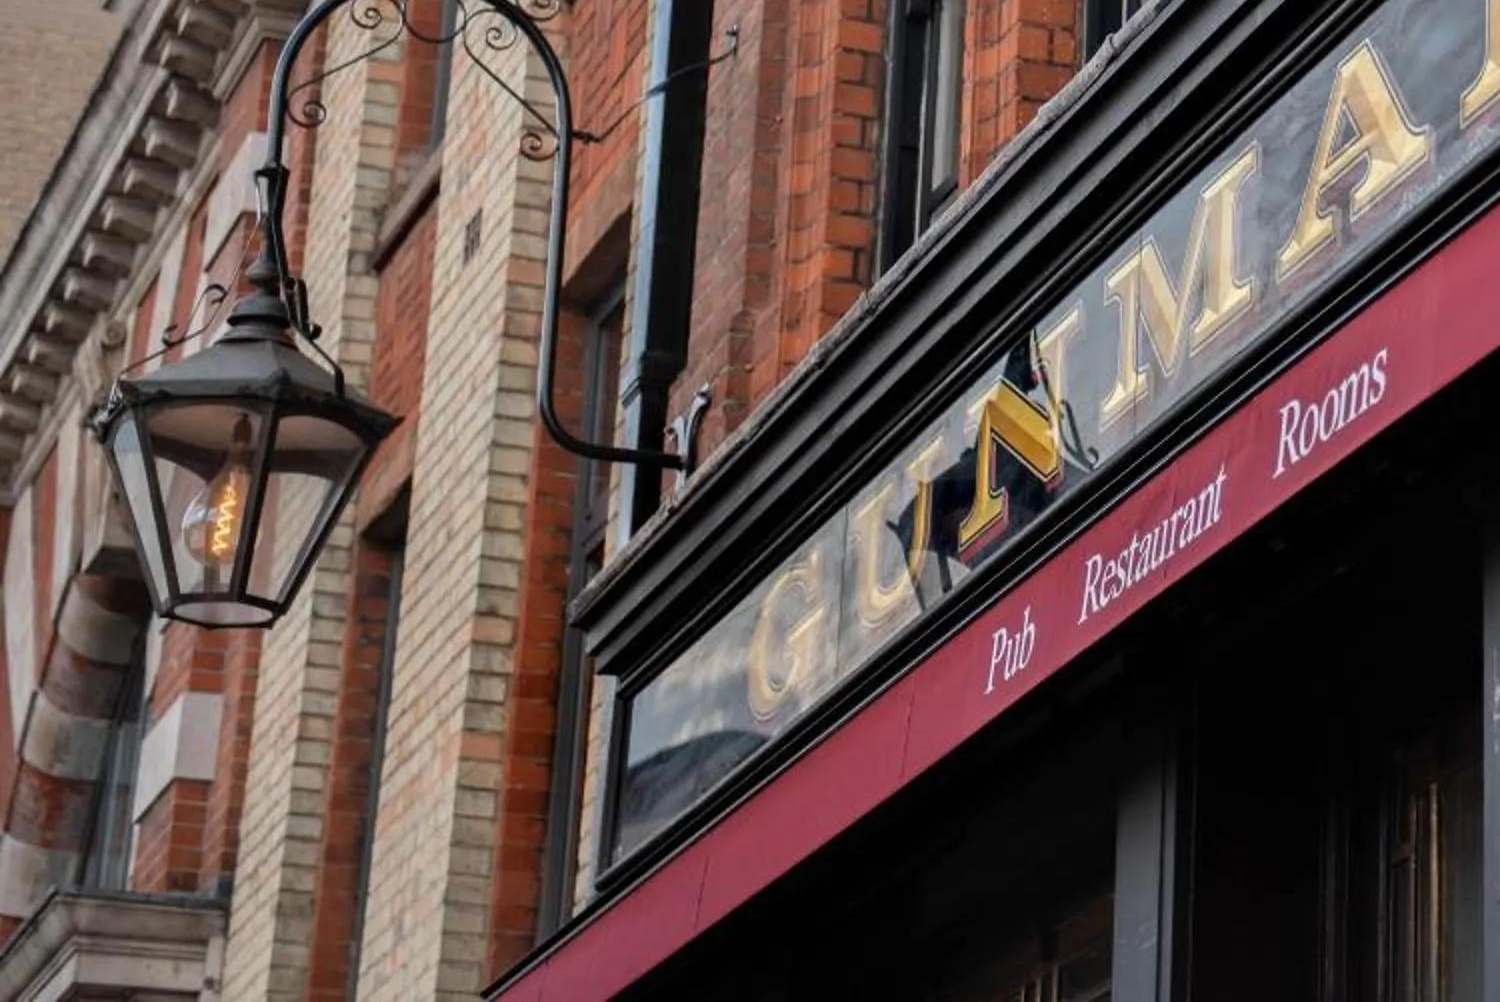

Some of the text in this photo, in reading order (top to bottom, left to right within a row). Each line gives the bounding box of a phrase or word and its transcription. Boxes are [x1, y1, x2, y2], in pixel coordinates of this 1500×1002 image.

[984, 348, 1388, 695] Pub Restaurant Rooms
